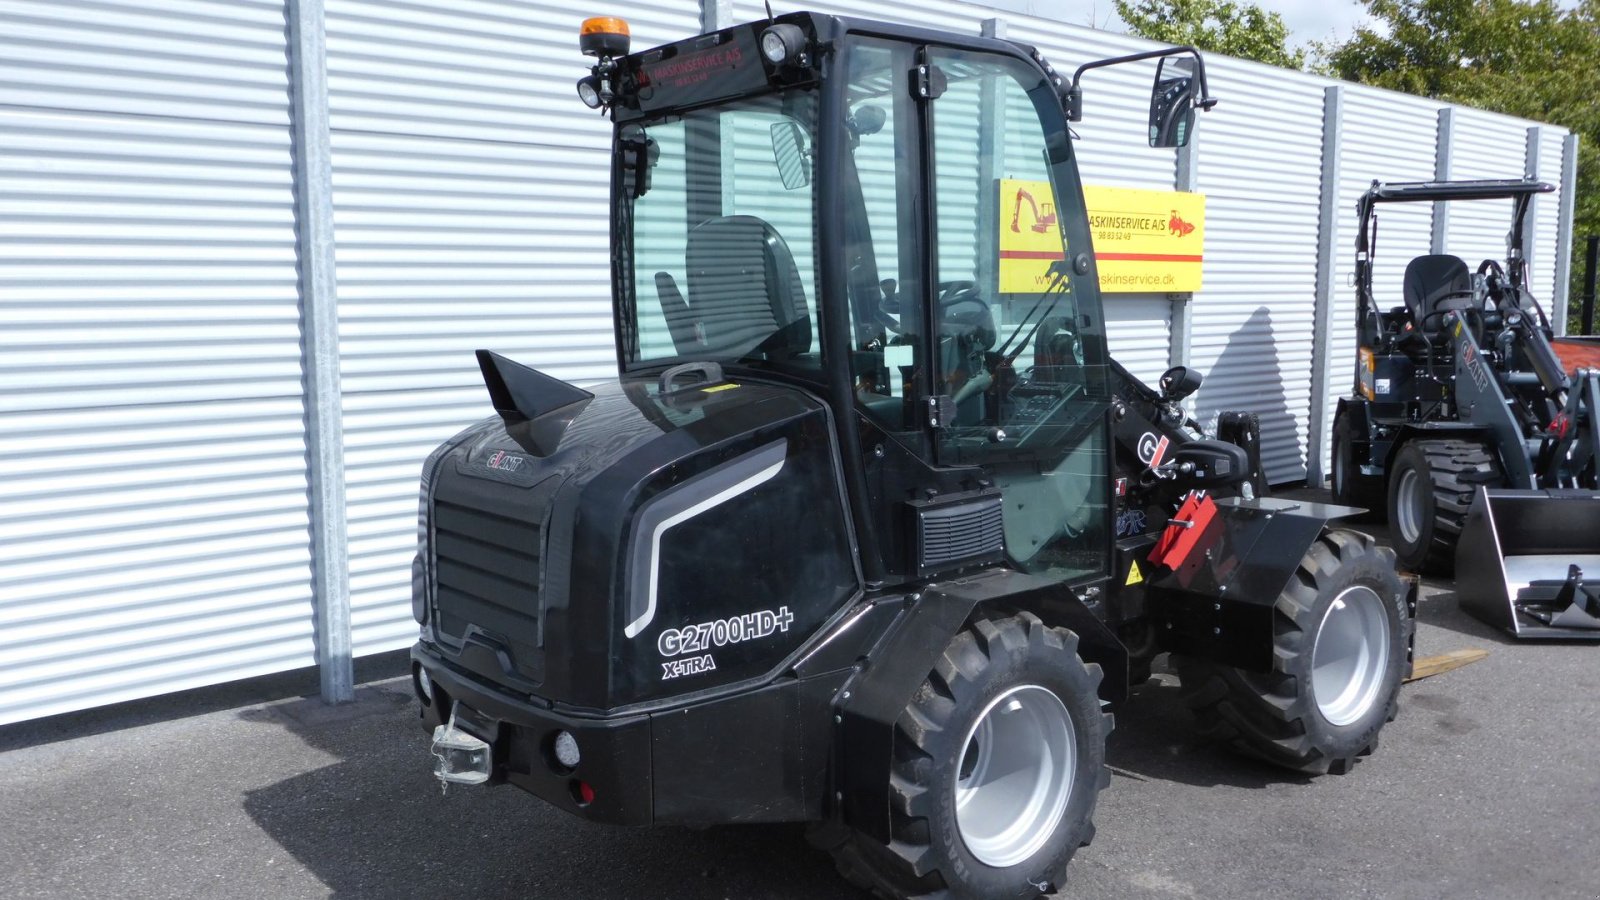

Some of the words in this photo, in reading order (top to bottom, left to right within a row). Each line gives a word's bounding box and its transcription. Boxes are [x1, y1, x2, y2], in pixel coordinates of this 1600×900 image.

[1089, 215, 1150, 230] ASKINSERVICE
[1151, 219, 1166, 231] A/S
[486, 450, 523, 472] GIANT
[657, 605, 794, 657] G2700HD+
[661, 654, 716, 680] X-TRA
